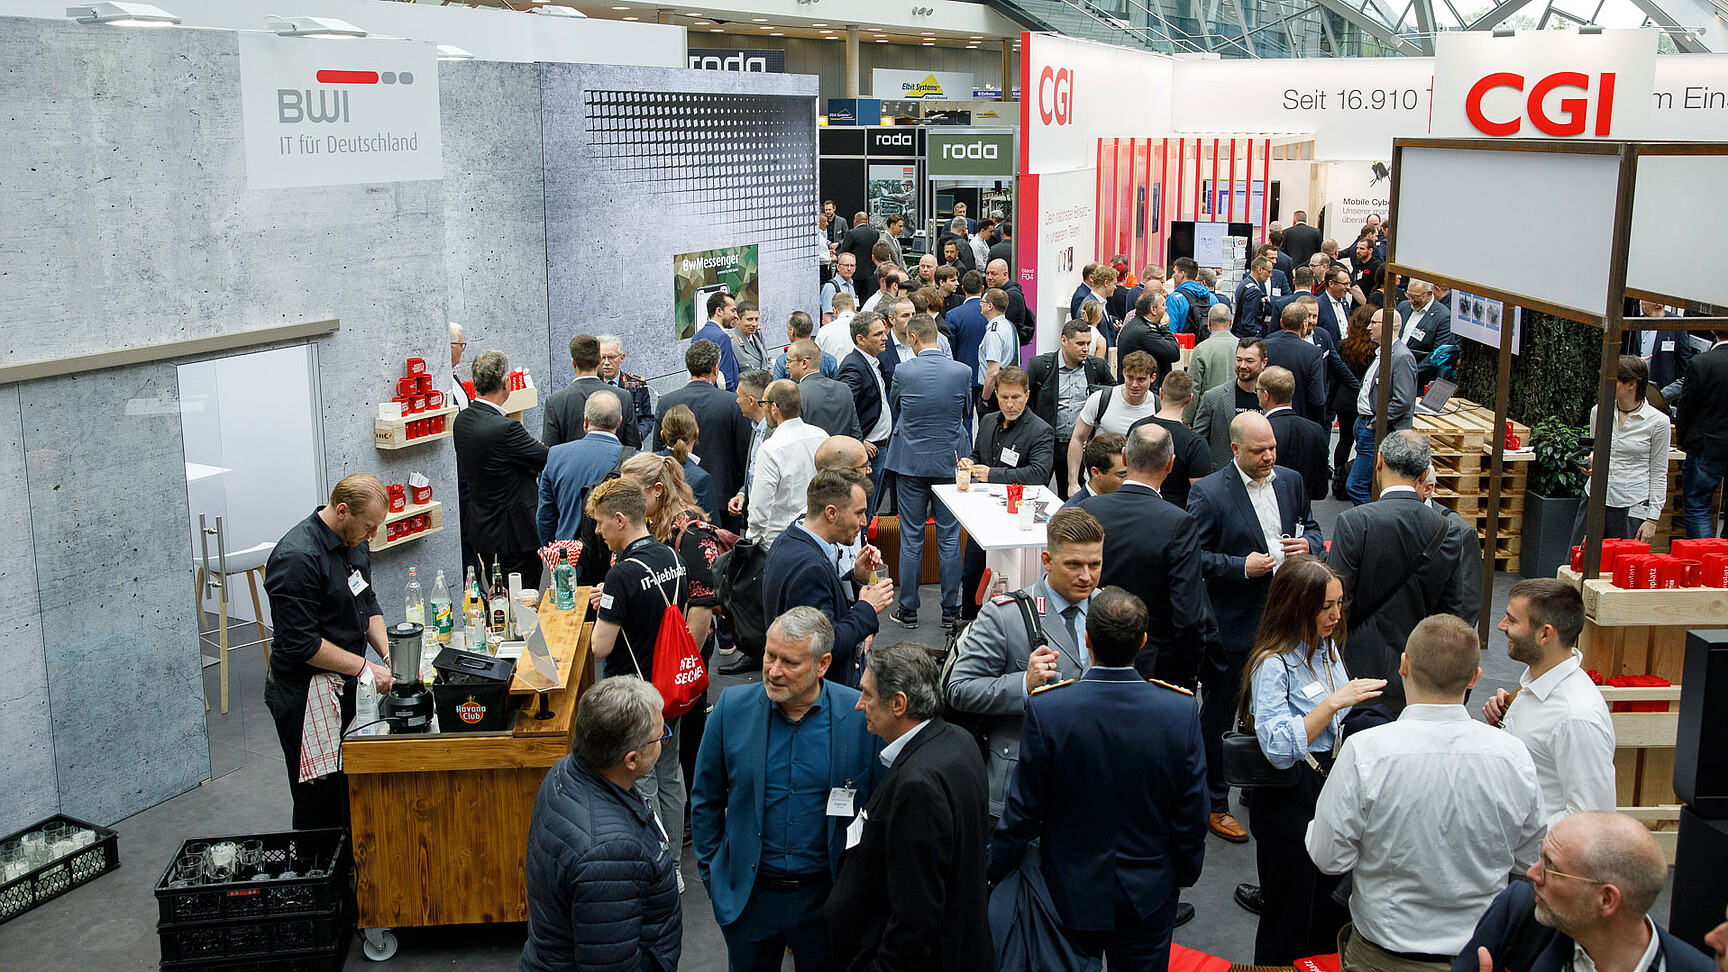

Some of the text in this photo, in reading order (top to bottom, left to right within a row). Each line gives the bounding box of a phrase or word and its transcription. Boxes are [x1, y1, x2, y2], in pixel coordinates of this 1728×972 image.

[689, 52, 766, 72] roda
[902, 82, 938, 93] Elbit Systems
[1038, 65, 1074, 126] CGI
[277, 89, 350, 124] BWI
[1283, 89, 1326, 110] Seit
[1337, 89, 1418, 110] 16.910
[1684, 86, 1728, 109] Ein
[1465, 71, 1616, 137] CGI
[280, 132, 418, 155] IT für Deutschland
[876, 133, 912, 146] roda
[943, 141, 998, 160] roda
[1343, 198, 1370, 206] Mobile
[683, 254, 739, 272] BwMessenger
[456, 705, 486, 713] Havana
[463, 712, 481, 720] Club
